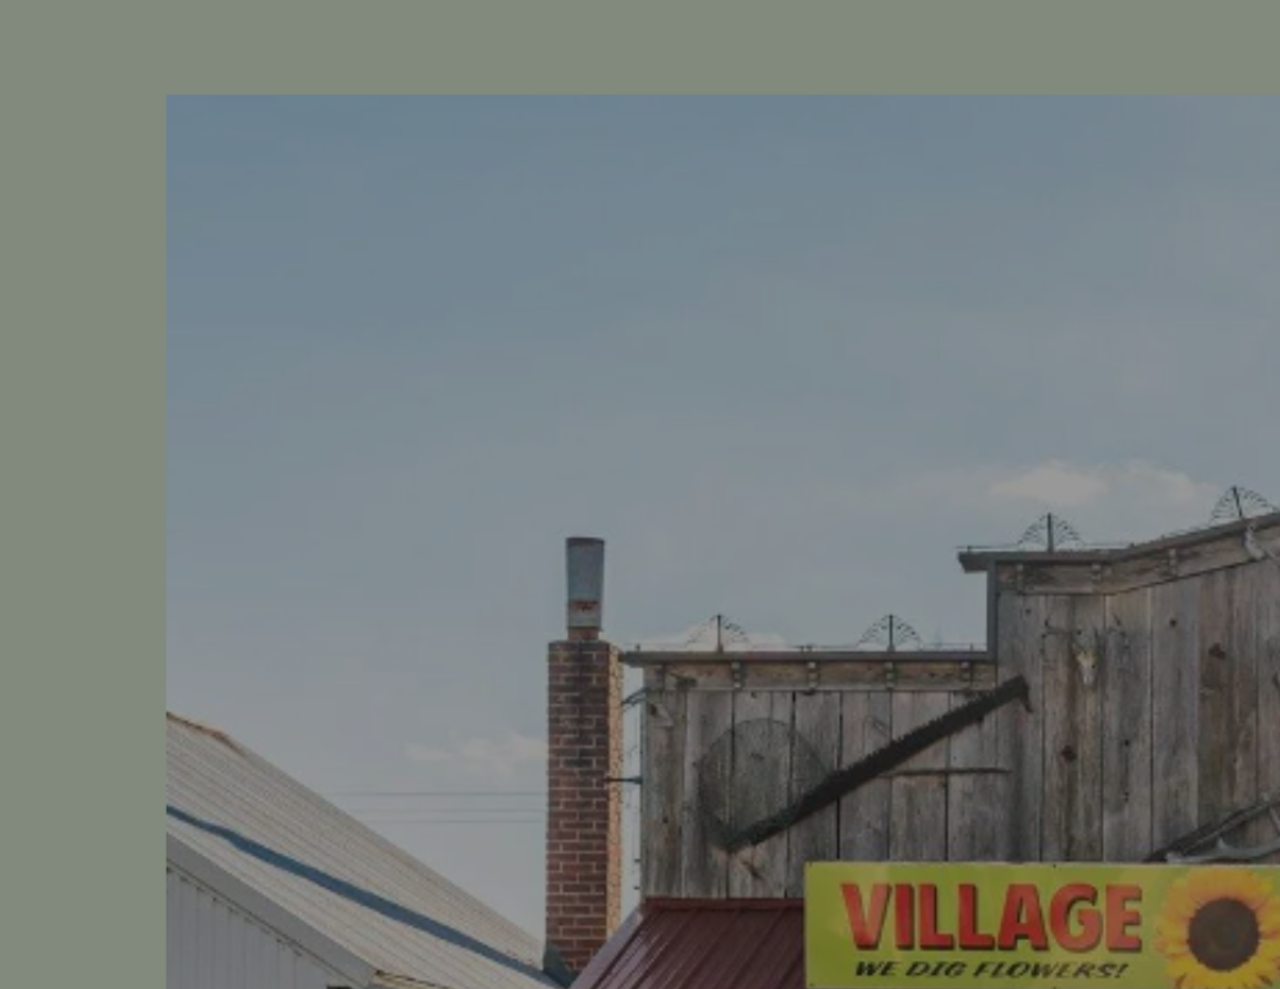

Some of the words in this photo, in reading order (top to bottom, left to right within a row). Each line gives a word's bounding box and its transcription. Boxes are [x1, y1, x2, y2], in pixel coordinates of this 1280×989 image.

[840, 882, 1142, 953] VILLAGE
[855, 961, 899, 978] WE
[906, 961, 968, 978] DIG
[973, 961, 1129, 979] FLOWERS!
